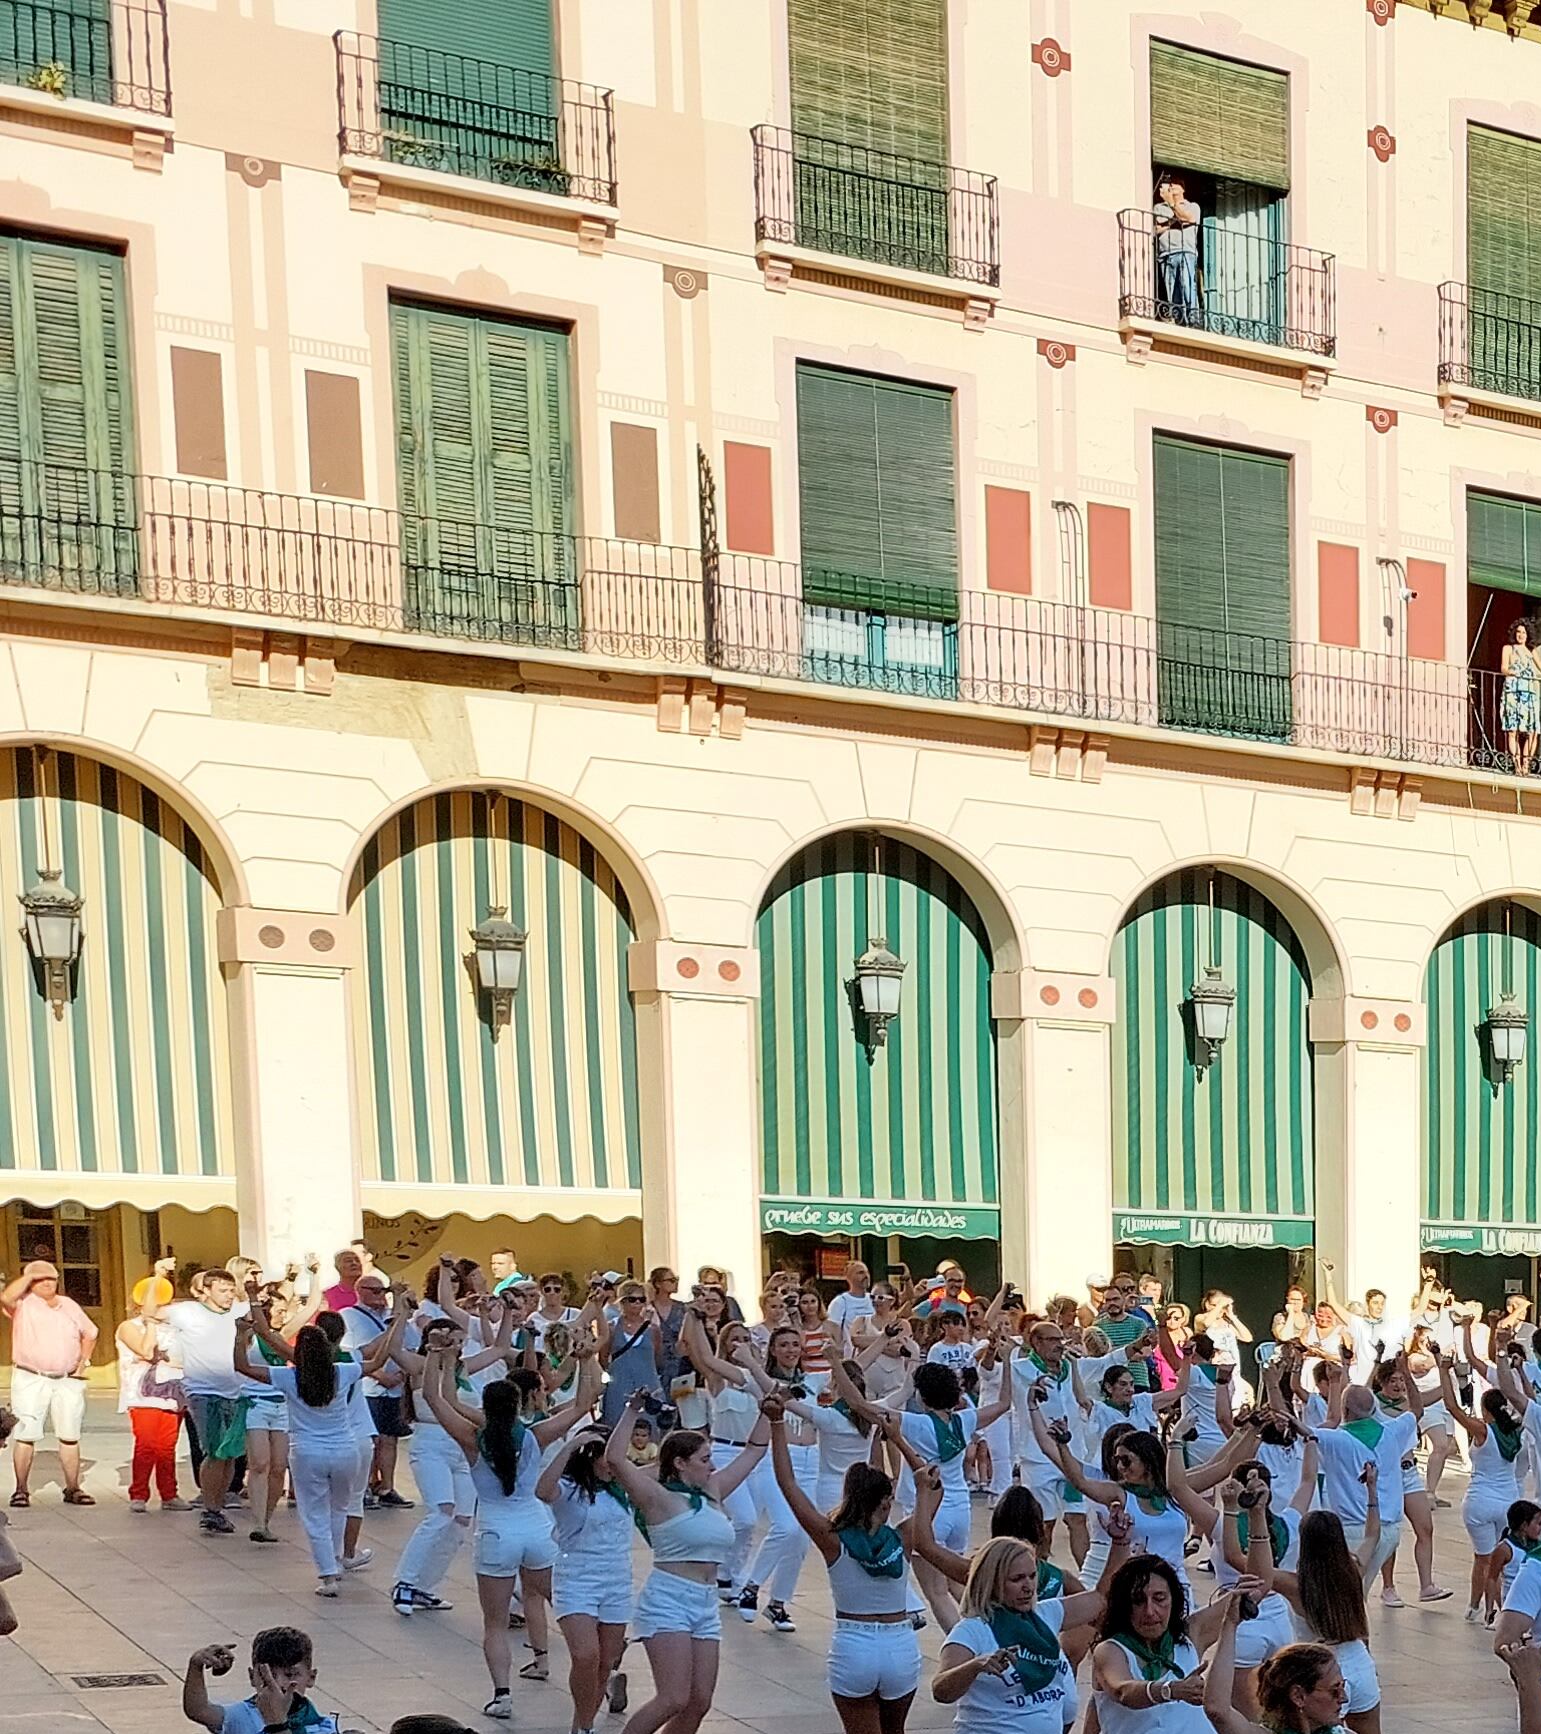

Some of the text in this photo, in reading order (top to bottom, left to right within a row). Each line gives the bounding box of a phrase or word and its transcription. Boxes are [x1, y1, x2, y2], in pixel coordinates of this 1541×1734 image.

[765, 1206, 967, 1232] pruebe sus especialidades
[1190, 1218, 1206, 1243] LA
[1208, 1219, 1274, 1245] CONFIANZA
[1481, 1229, 1497, 1252] LA
